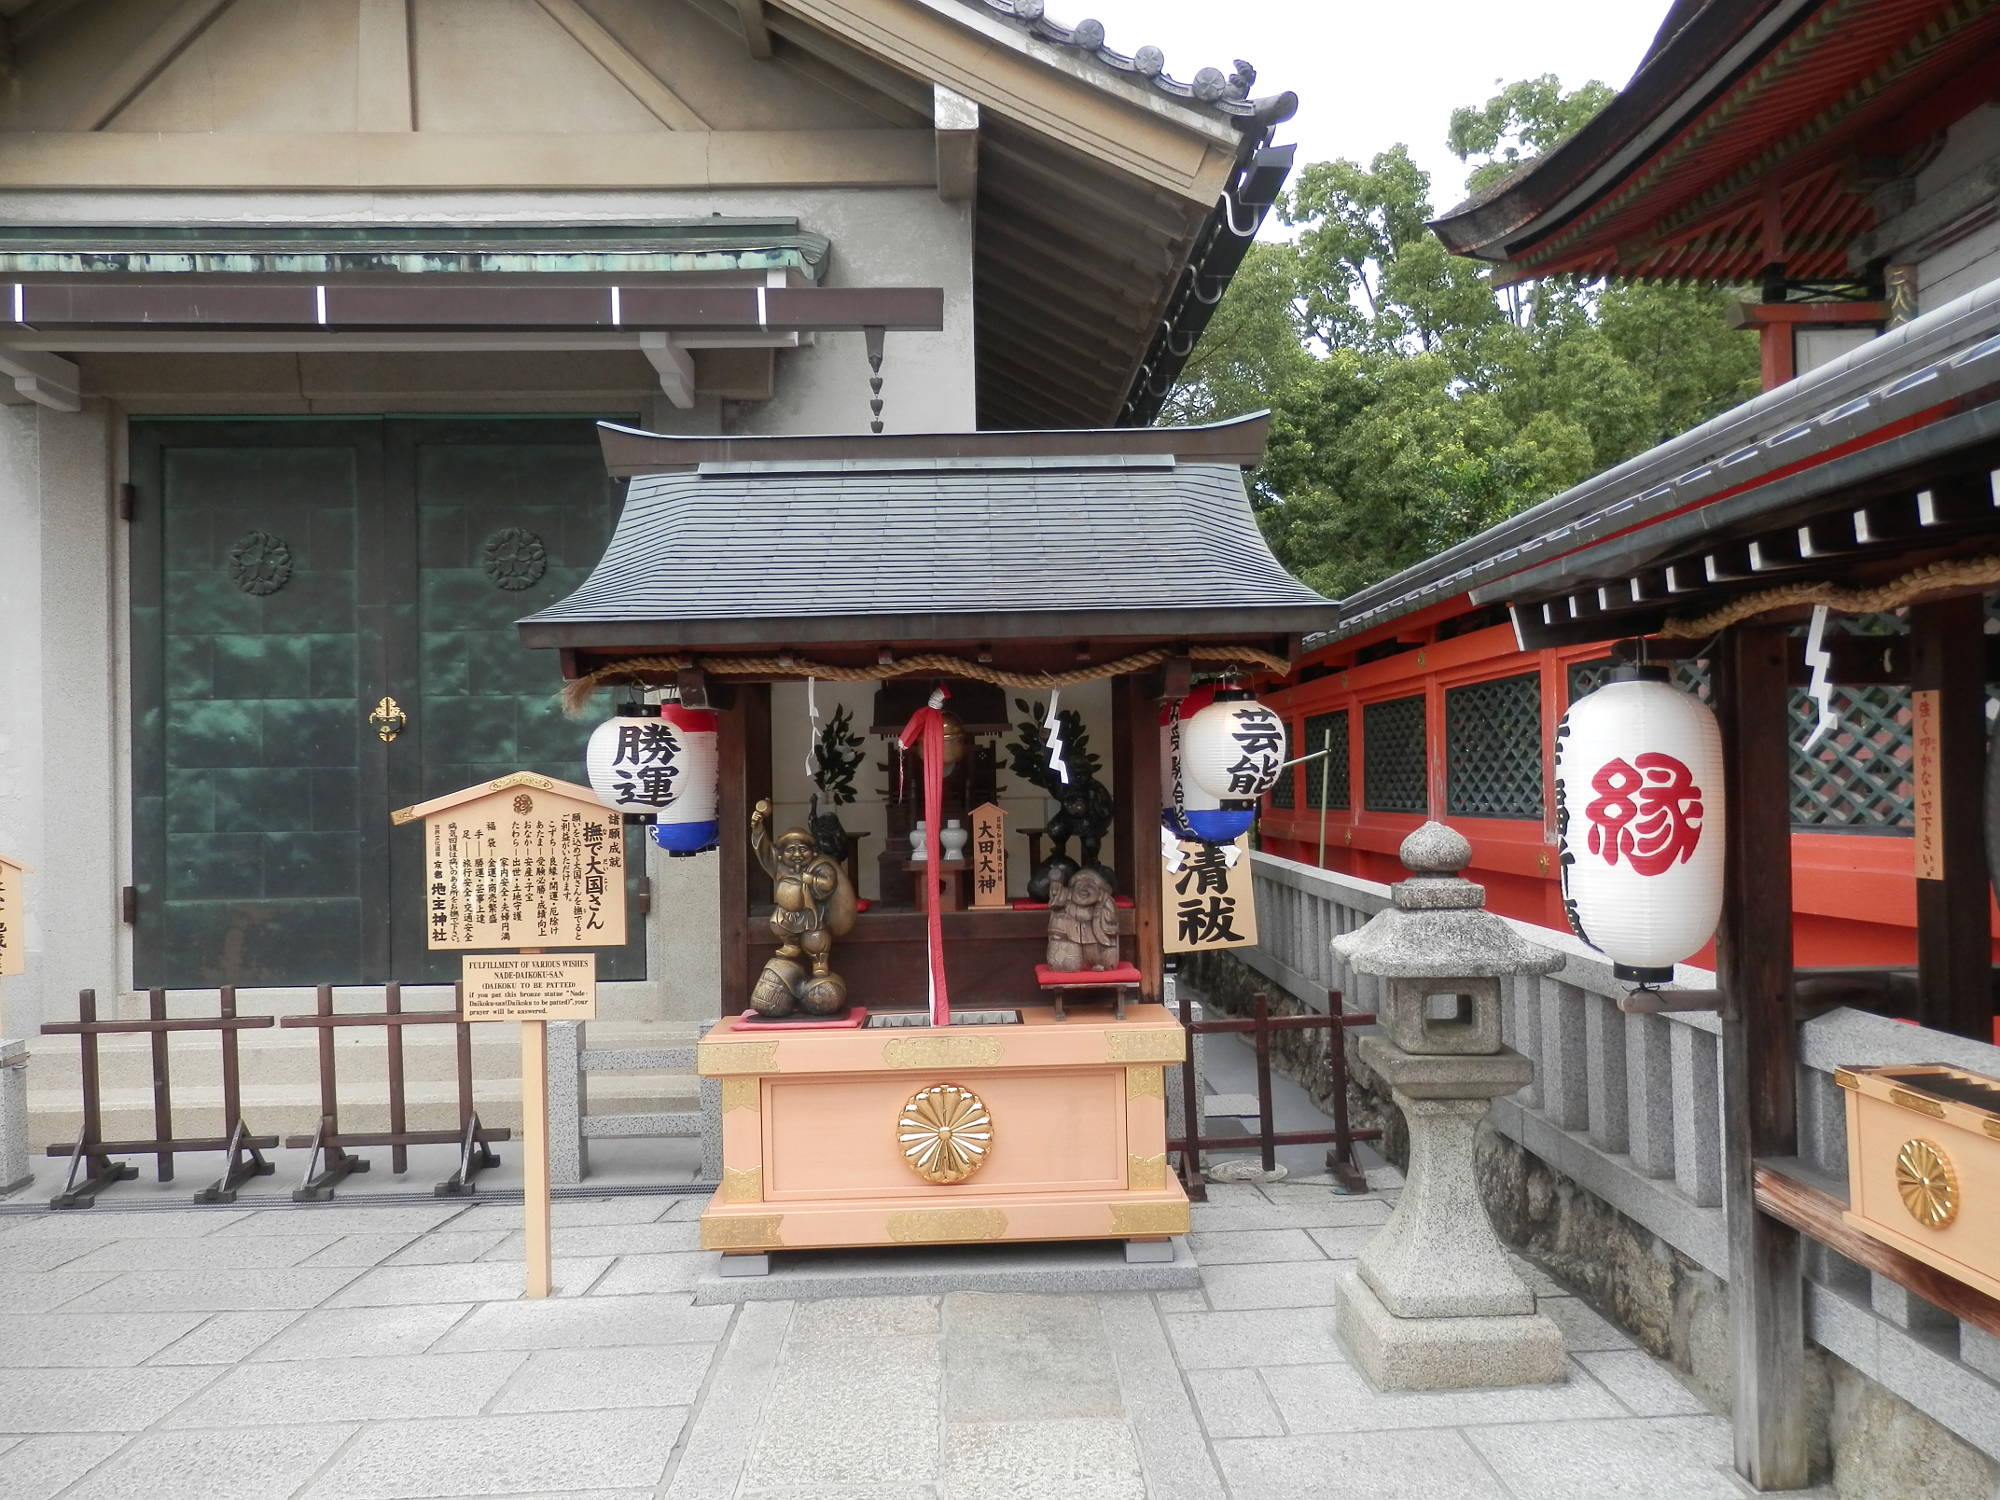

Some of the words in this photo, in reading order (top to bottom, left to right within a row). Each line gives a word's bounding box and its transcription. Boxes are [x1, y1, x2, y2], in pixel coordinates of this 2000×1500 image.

[612, 723, 682, 808] 勝運
[1226, 707, 1283, 794] 芸能
[608, 814, 621, 868] 諸願成就
[1585, 751, 1704, 877] 縁
[434, 861, 443, 879] 京都
[583, 822, 605, 930] 撫で大国さん
[978, 820, 996, 894] 大田大神
[431, 883, 448, 941] 地主神社
[1175, 847, 1245, 945] 清祓
[469, 961, 519, 969] FULFILLMENT
[531, 960, 561, 968] VARIOUS
[562, 960, 589, 968] WISHES
[494, 970, 564, 979] NADE-DAIKOKU-SAN
[469, 1008, 489, 1016] prayer
